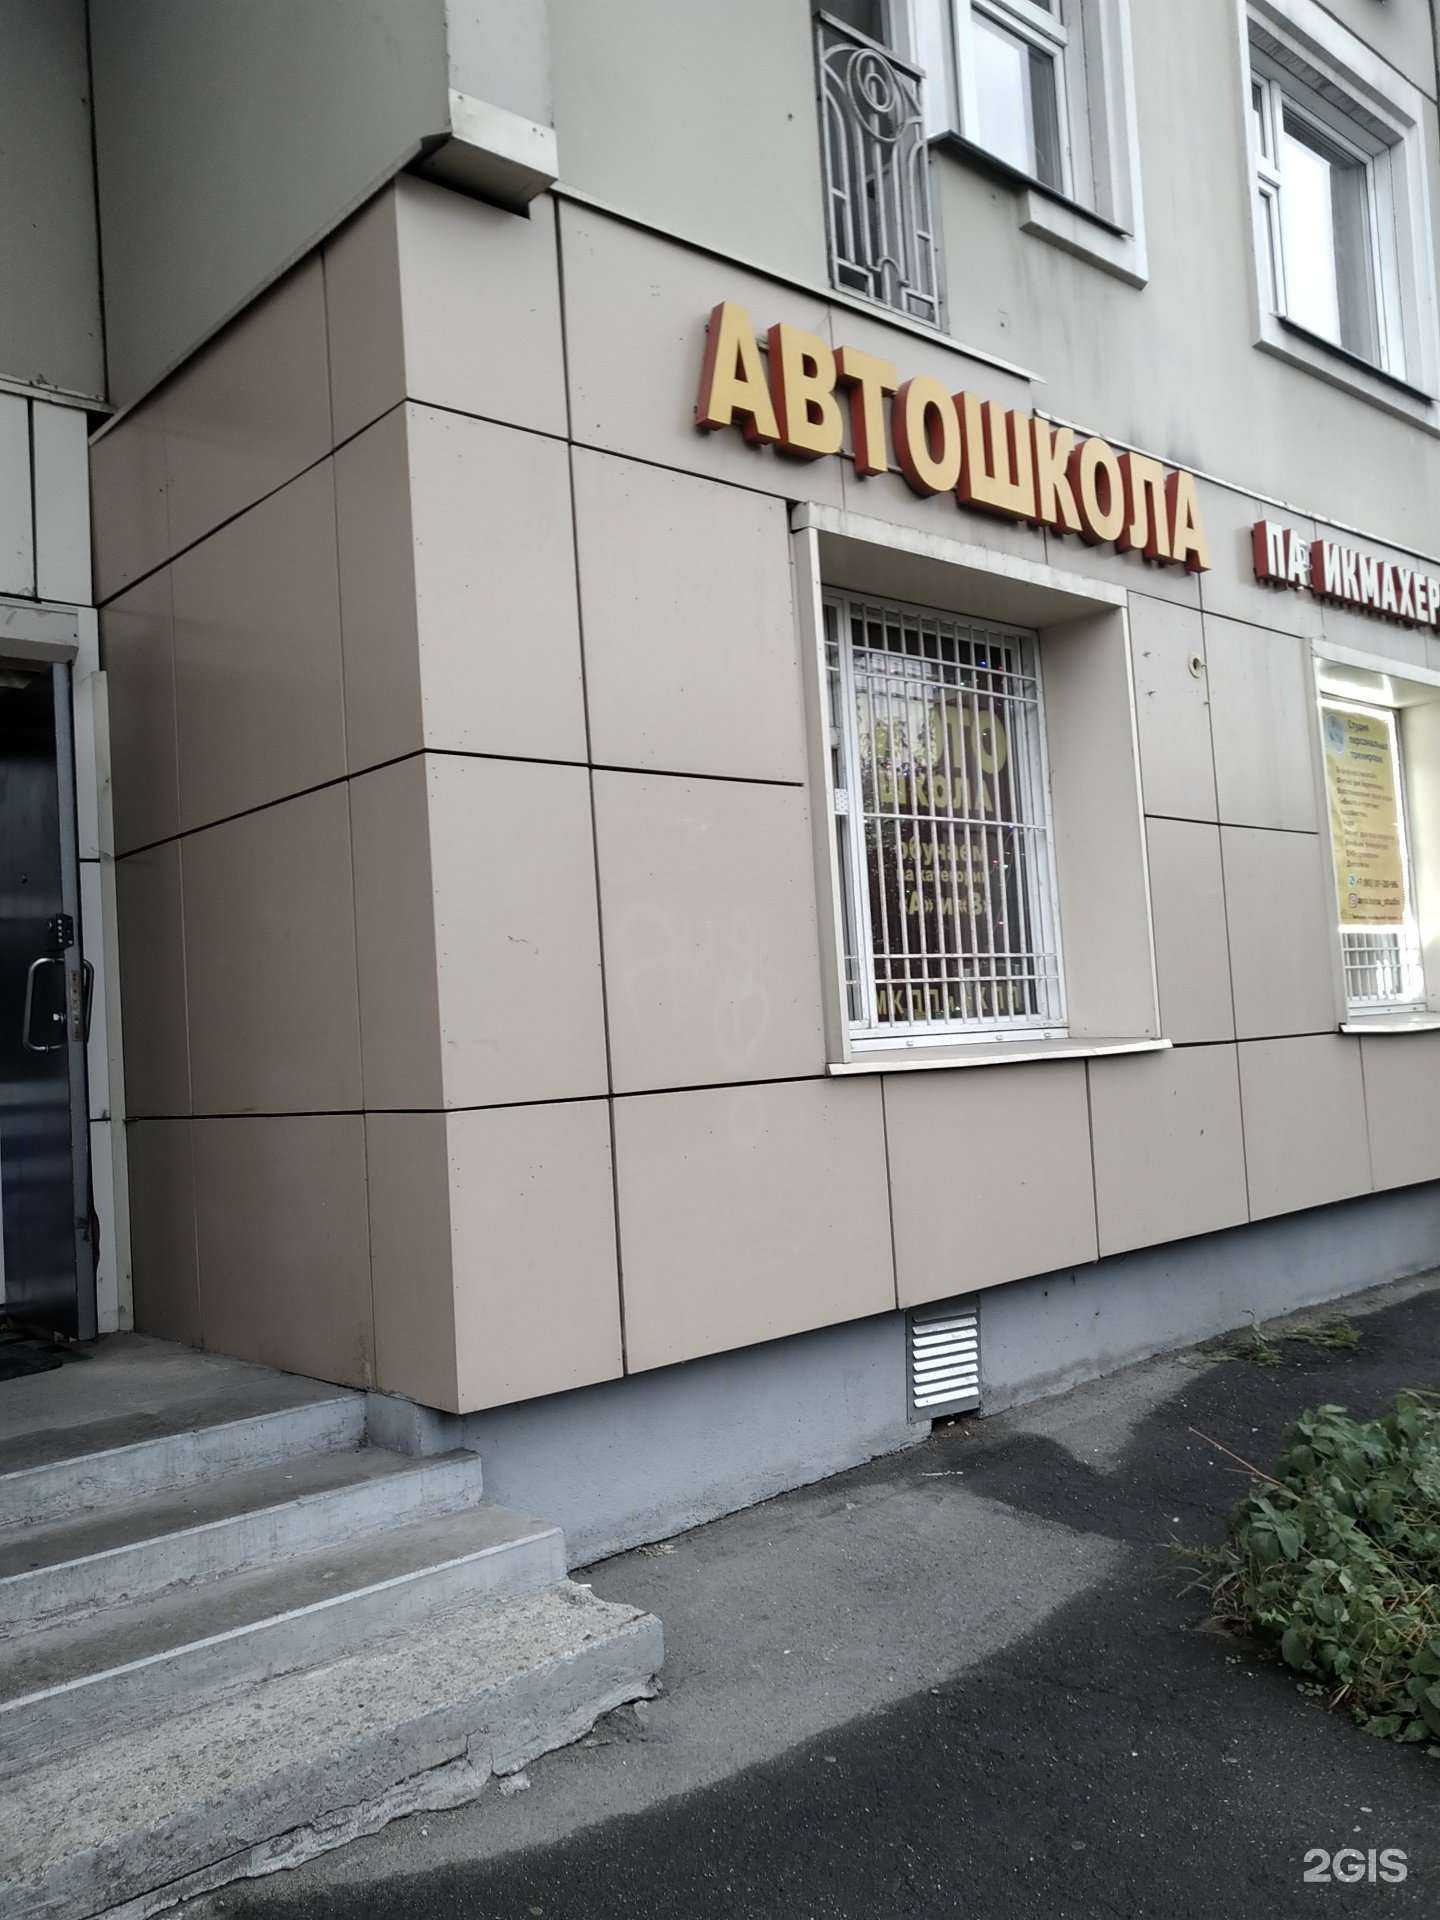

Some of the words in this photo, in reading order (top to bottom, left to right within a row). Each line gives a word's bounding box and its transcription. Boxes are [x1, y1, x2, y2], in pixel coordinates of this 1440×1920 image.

[697, 302, 1211, 572] АВТОШКОЛА
[897, 868, 914, 882] а
[919, 869, 987, 886] каеории
[899, 890, 933, 914] А»
